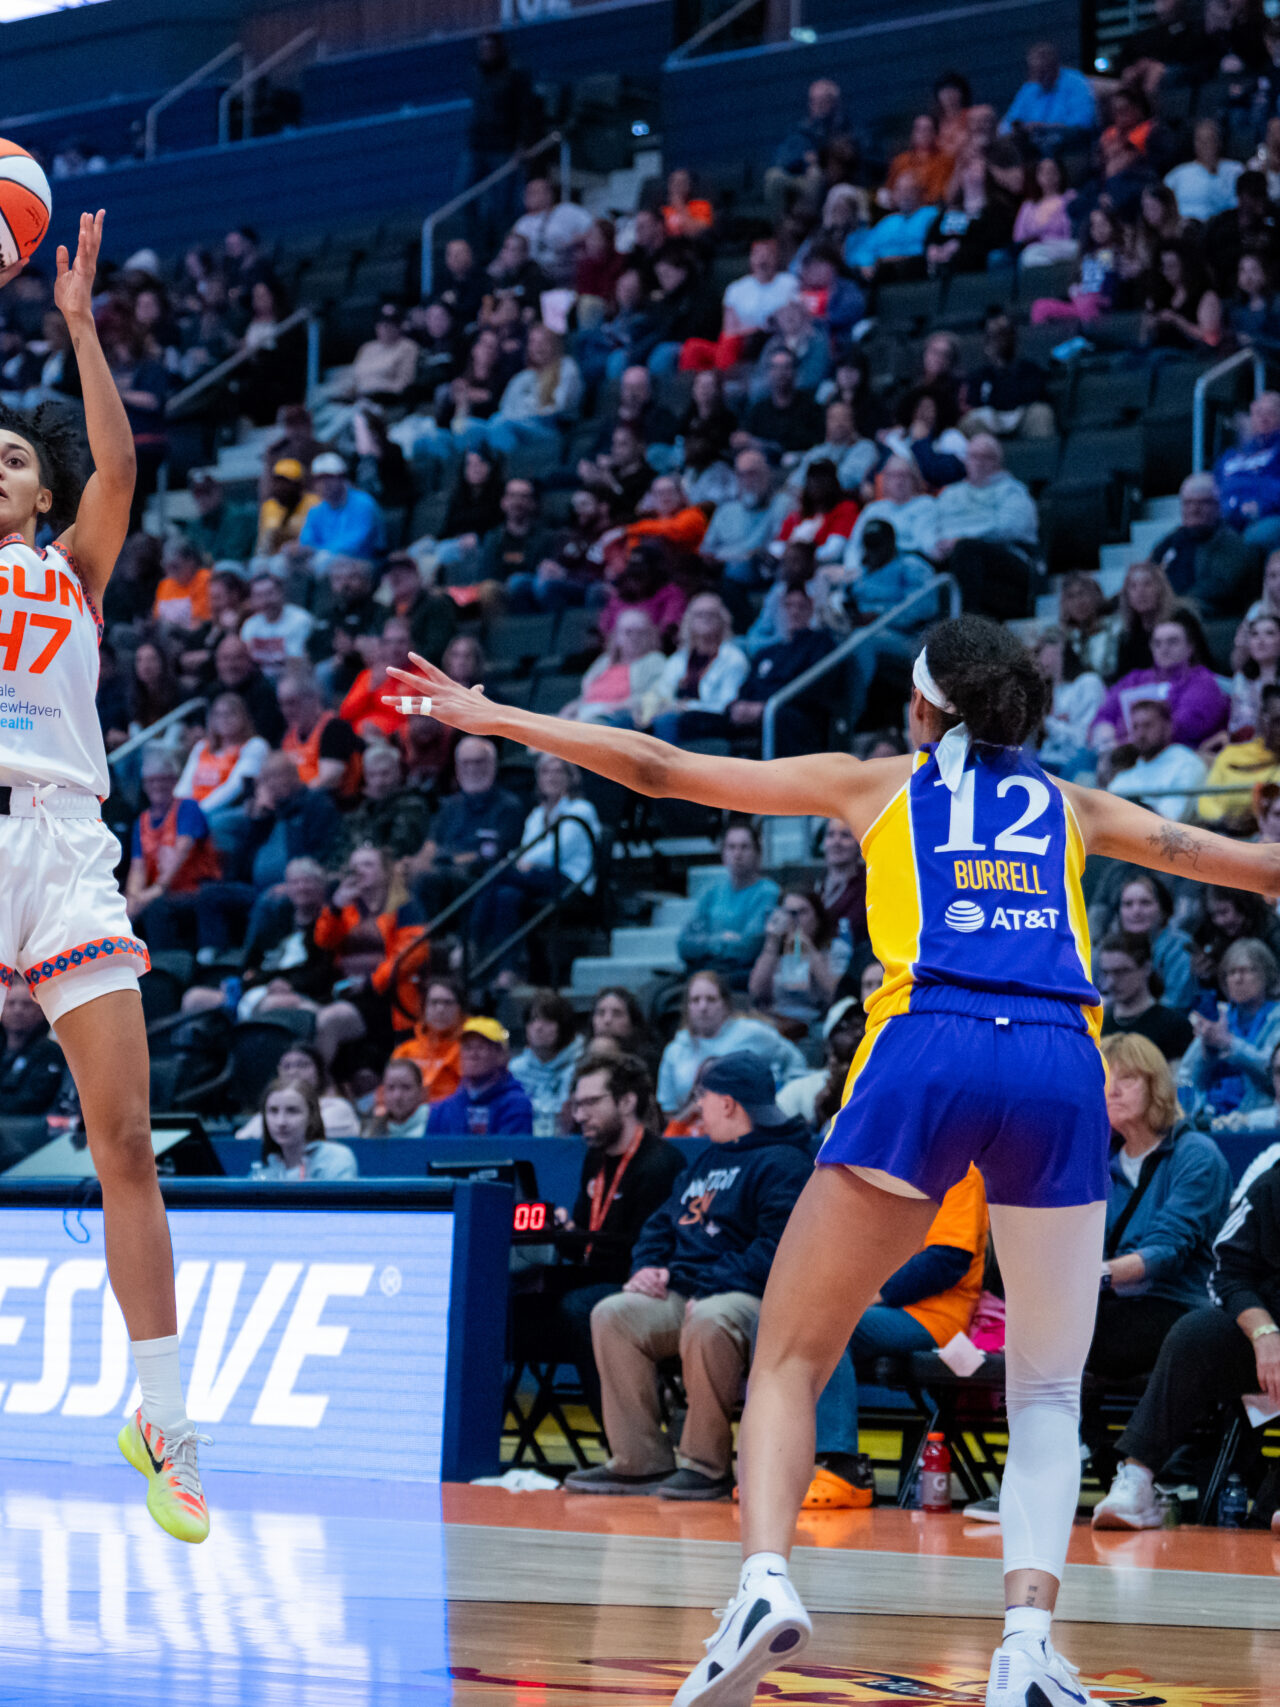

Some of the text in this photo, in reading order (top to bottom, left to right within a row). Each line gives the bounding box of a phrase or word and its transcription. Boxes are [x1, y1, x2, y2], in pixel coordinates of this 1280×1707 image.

[933, 769, 1051, 855] 12
[953, 860, 1047, 895] BURRELL
[990, 907, 1059, 930] AT&T
[513, 1203, 546, 1231] 00
